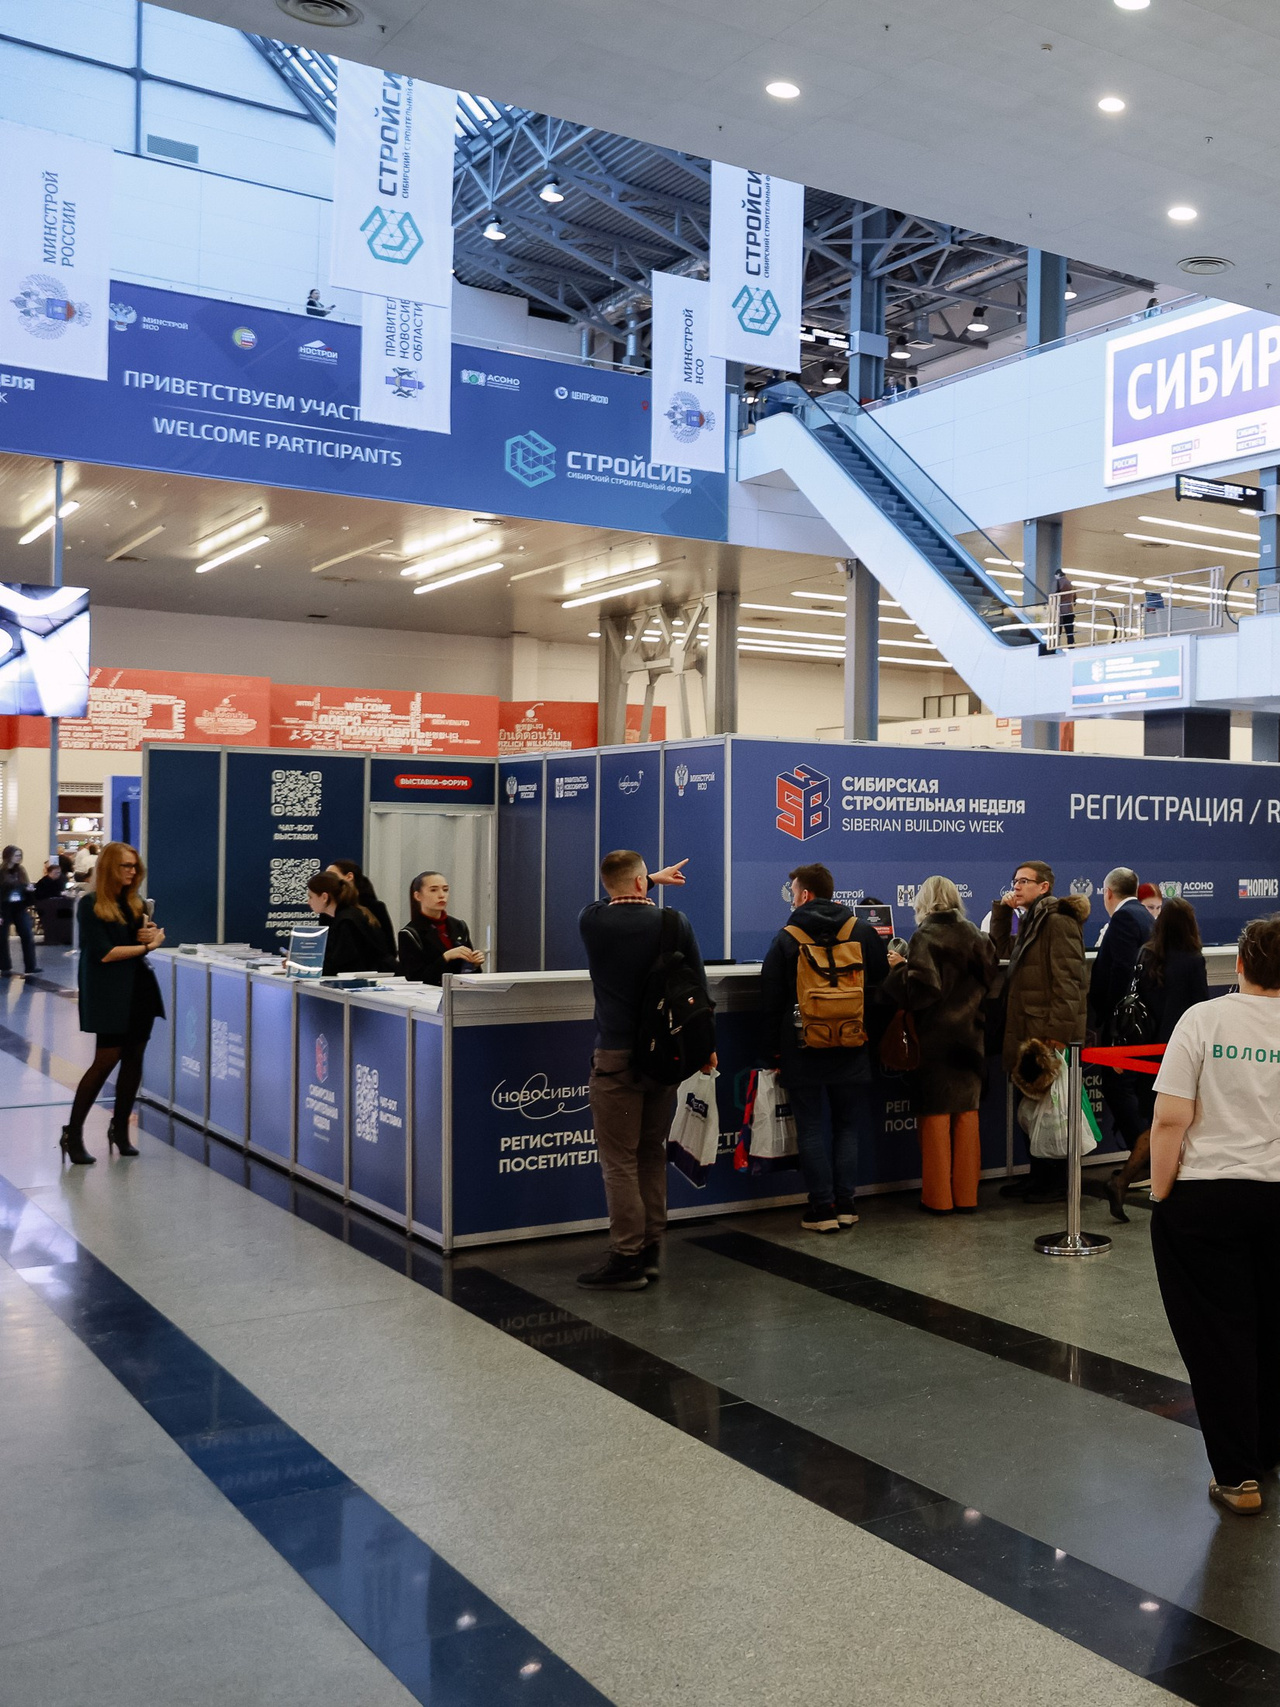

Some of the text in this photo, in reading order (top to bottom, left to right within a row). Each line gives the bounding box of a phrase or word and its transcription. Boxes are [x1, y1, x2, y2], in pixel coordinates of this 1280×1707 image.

[42, 171, 58, 264] МИНСТРОЙ
[61, 201, 75, 268] РОССИИ
[142, 316, 189, 330] МИНСТРОЙ
[412, 303, 423, 362] ОБЛАСТИ
[683, 309, 694, 383] МИНСТРОЙ
[487, 374, 520, 386] АСОНО
[696, 358, 705, 385] НСО
[123, 370, 295, 412] ПРИВЕТСТВУЕМ
[153, 416, 402, 467] WELCOME PARTICIPANTS
[566, 450, 693, 485] СТРОЙСИБ
[567, 471, 692, 495] СИБИРСКИЙ СТРОИТЕЛЬНЫЙ ФОРУМ
[400, 777, 468, 787] ВЫСТАВКА-ФОРУМ
[690, 772, 715, 782] МИНСТРОЙ
[842, 776, 939, 794] СИБИРСКАЯ
[842, 796, 1025, 815] СТРОИТЕЛЬНАЯ НЕДЕЛЯ
[1070, 793, 1243, 826] РЕГИСТРАЦИЯ
[1249, 799, 1262, 825] /
[842, 818, 1004, 833] SIBERIAN BUILDING WEEK
[273, 833, 318, 841] ВЫСТАВКИ
[1183, 882, 1214, 891] АСОНО
[1247, 879, 1279, 896] НОПРИЗ
